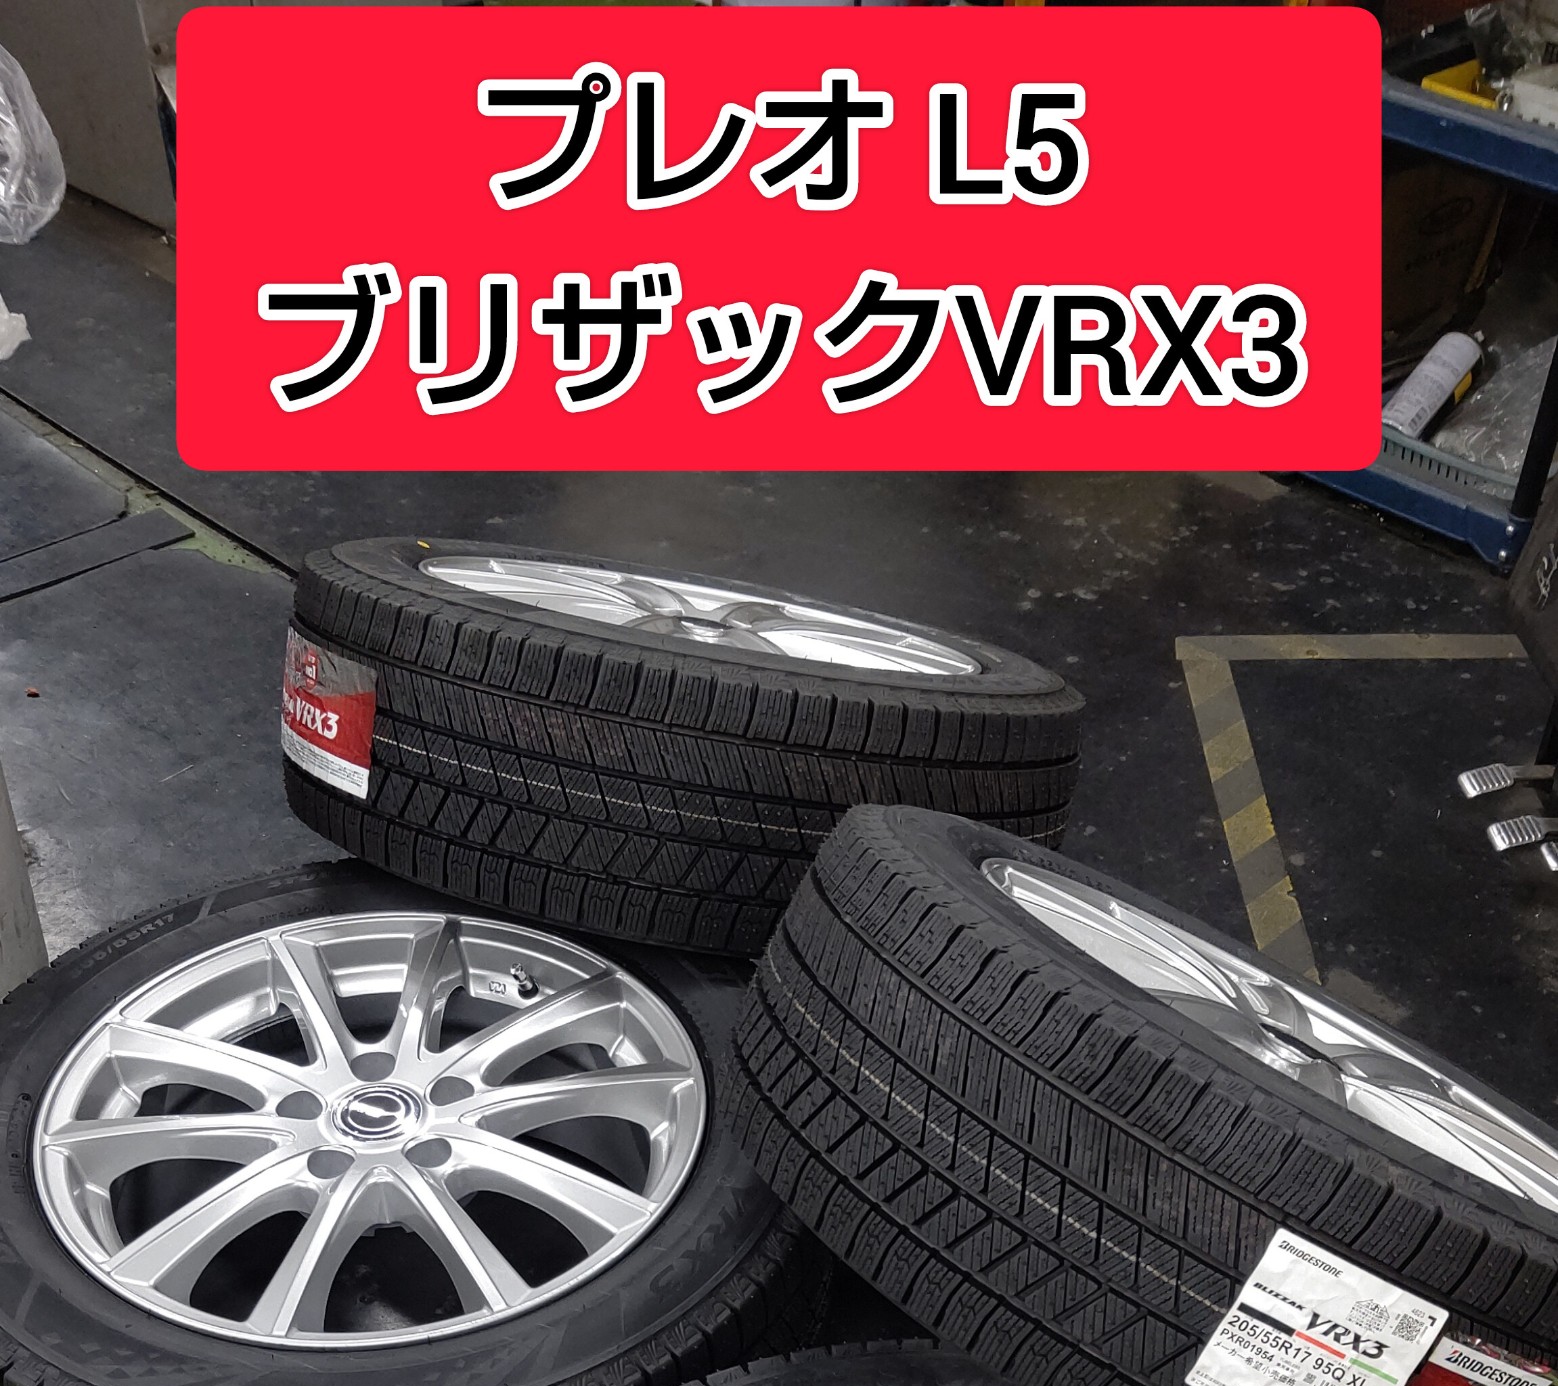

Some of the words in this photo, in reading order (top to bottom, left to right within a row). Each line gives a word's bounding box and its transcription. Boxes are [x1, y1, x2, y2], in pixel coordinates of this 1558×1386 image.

[295, 697, 340, 740] VRX3
[1277, 1239, 1344, 1279] BRIDGESTONE
[1252, 1281, 1306, 1312] BLIZZAK
[1219, 1327, 1276, 1363] PXR01954
[1227, 1314, 1312, 1364] 205/55R17
[1312, 1356, 1346, 1383] 95Q
[1304, 1310, 1391, 1360] VRX3
